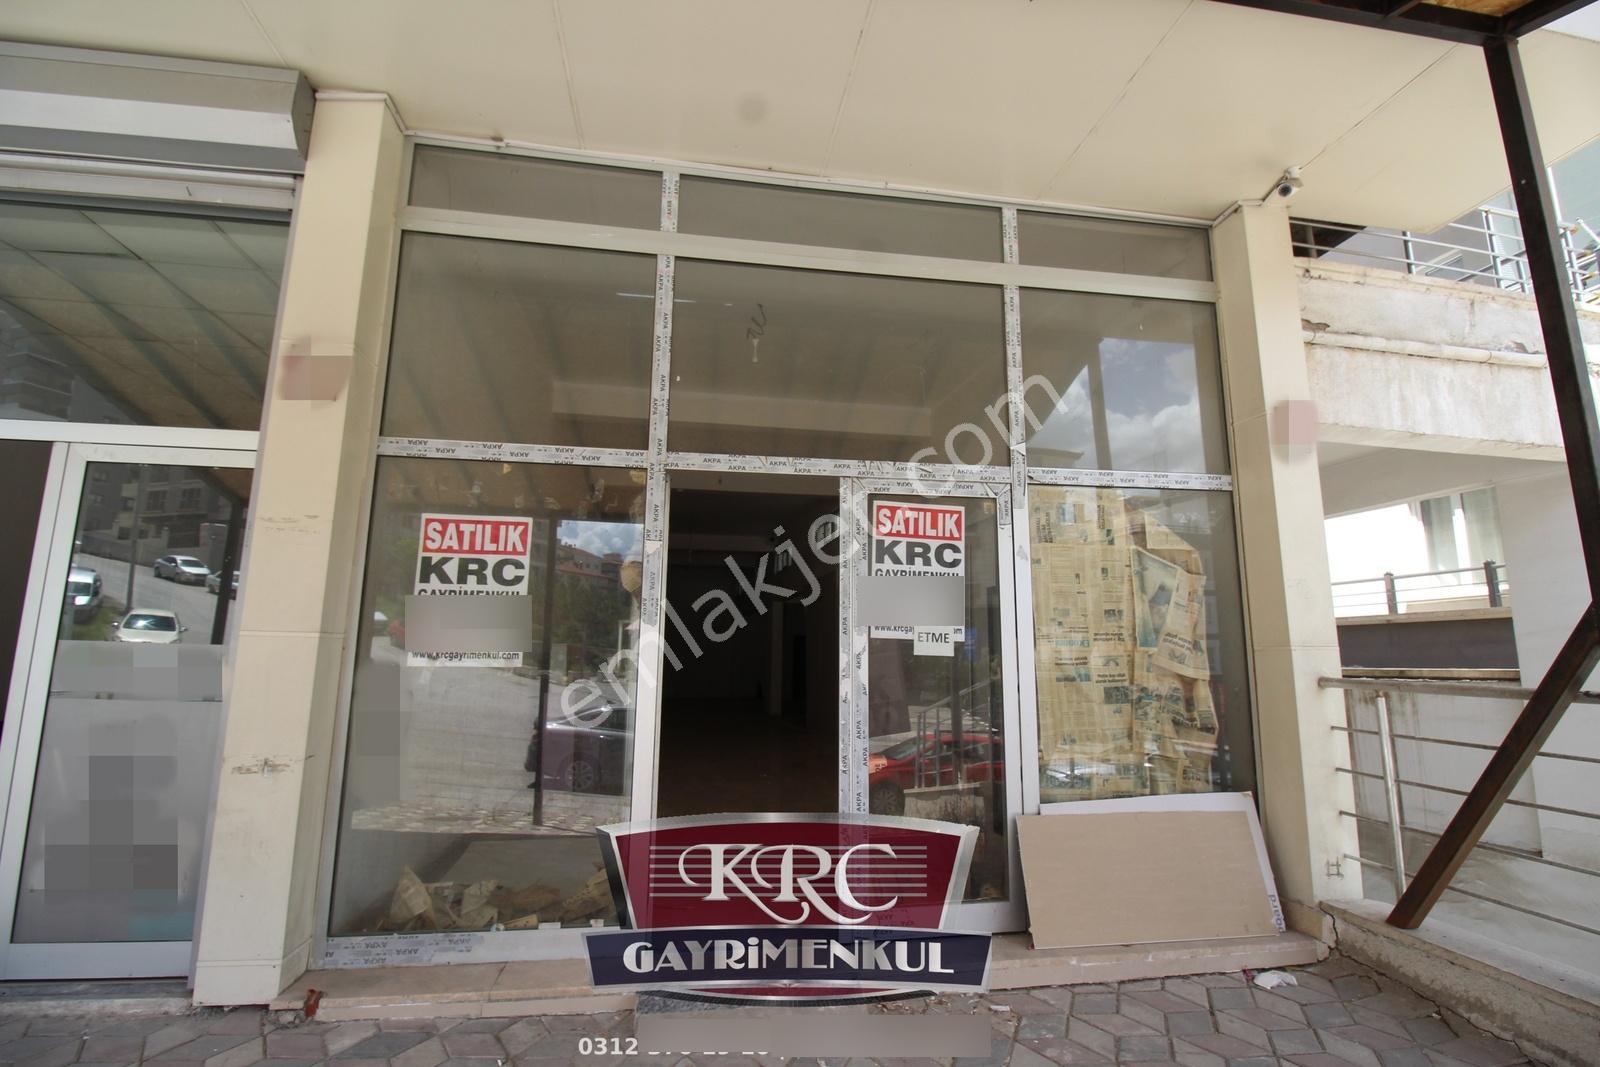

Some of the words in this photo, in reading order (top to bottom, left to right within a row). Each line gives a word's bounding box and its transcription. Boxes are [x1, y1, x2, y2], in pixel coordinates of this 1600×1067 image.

[425, 521, 525, 552] SATILIK
[878, 508, 961, 538] SATILIK
[875, 539, 962, 569] KRC
[419, 556, 525, 586] KRC
[917, 632, 950, 644] ETME
